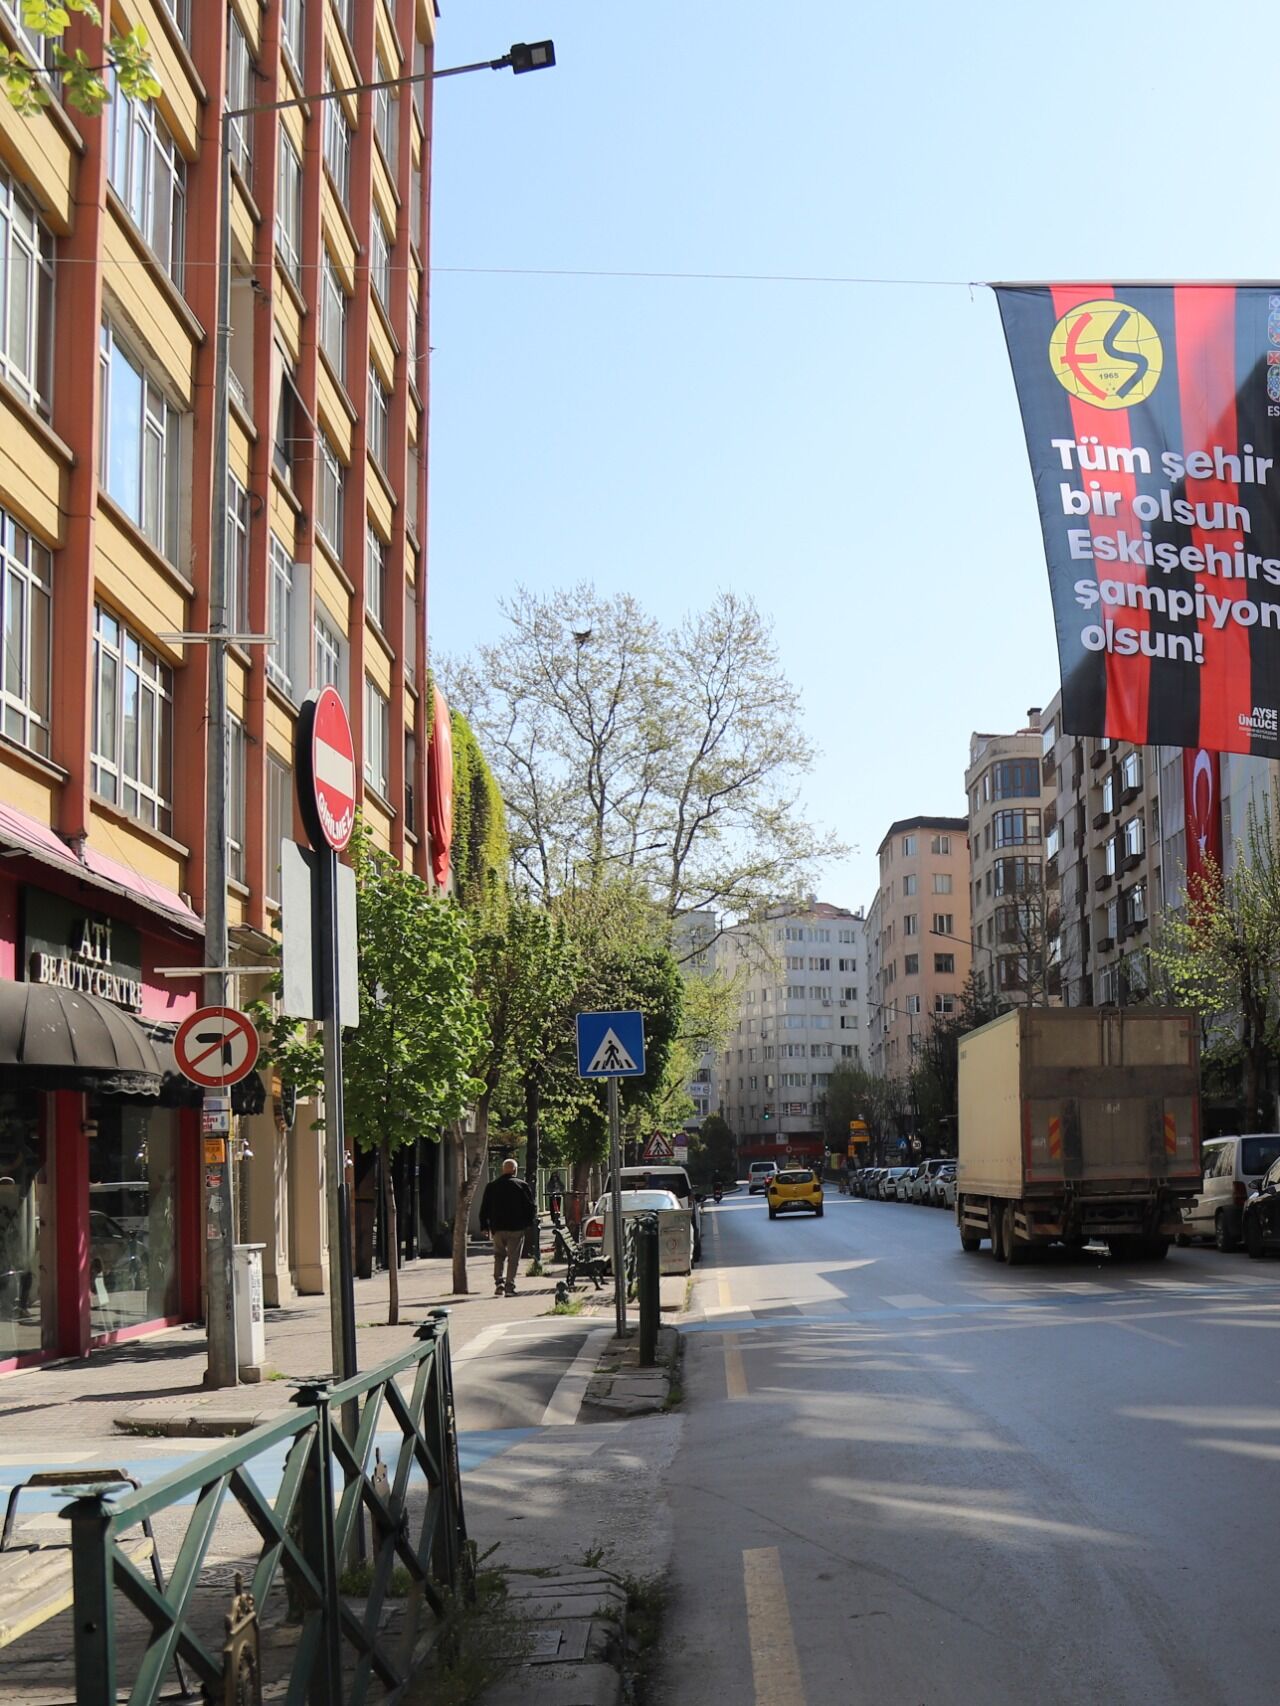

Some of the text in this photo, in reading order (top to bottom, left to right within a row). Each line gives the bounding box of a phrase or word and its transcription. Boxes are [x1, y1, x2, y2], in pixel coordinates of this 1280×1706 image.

[1099, 372, 1120, 381] 1965
[1051, 436, 1274, 485] Tüm şehir
[1060, 481, 1251, 533] bir olsun
[1081, 619, 1205, 664] olsun!
[1238, 714, 1278, 731] ÜNLÜCE
[1252, 706, 1278, 720] AYŞE
[317, 791, 353, 841] GİRİLMEZ
[79, 917, 113, 967] ATİ
[39, 952, 143, 1008] BEAUTY CENTRE
